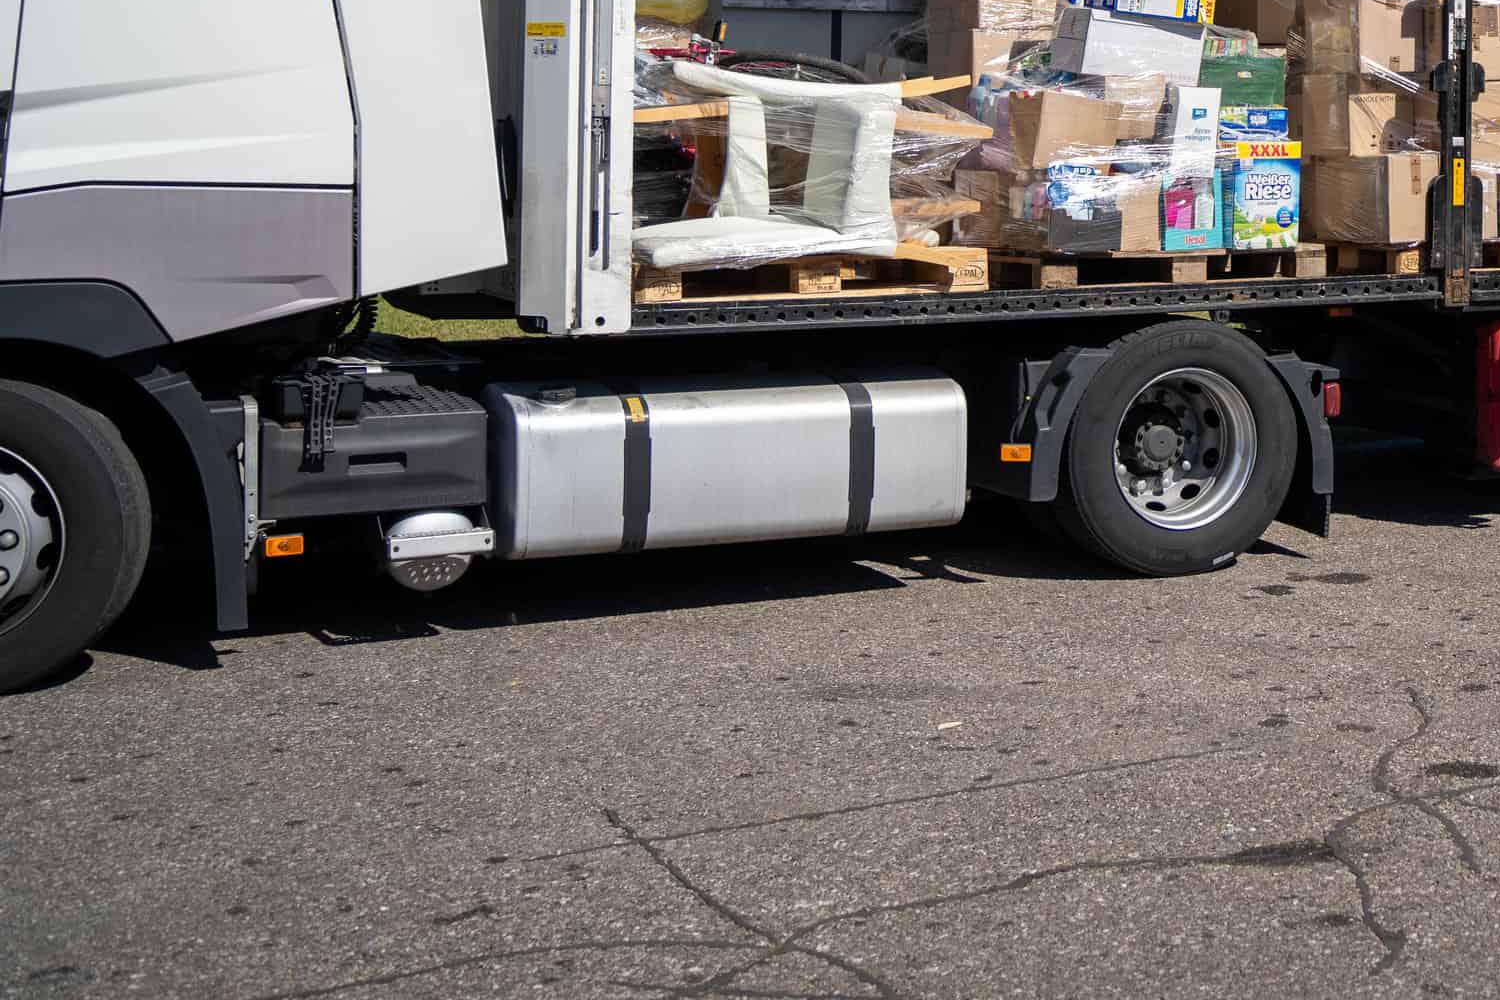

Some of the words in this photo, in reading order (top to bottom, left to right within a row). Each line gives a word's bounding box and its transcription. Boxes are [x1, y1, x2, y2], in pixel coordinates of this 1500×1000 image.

[1249, 144, 1289, 158] XXXL
[1247, 172, 1291, 185] Weißer
[1245, 183, 1293, 201] Riese
